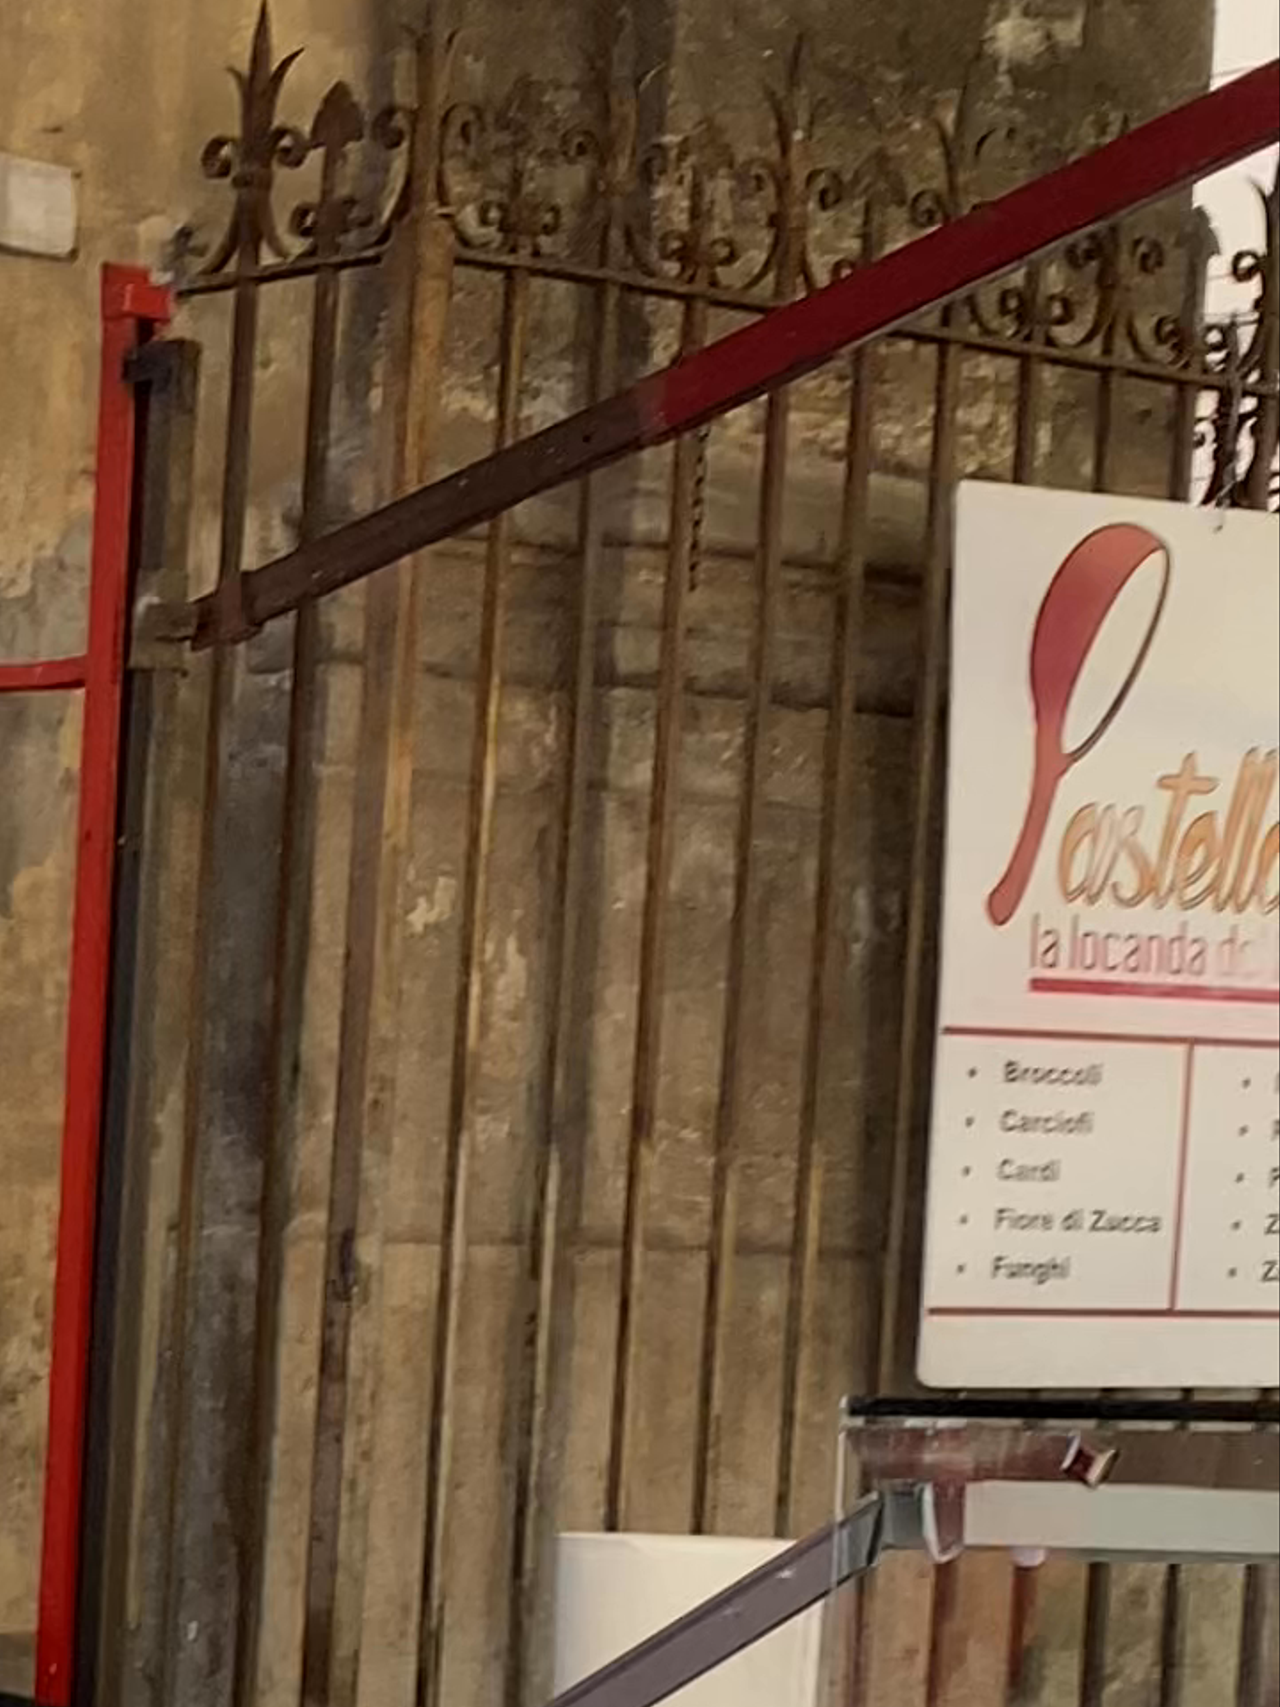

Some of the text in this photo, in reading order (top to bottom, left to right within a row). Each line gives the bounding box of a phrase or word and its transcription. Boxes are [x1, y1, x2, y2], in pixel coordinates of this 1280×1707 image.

[1030, 912, 1060, 969] la
[1069, 913, 1208, 977] locanda
[1002, 1060, 1104, 1087] Broccoli
[999, 1108, 1095, 1134] Carciofi
[996, 1158, 1061, 1182] Cardi
[994, 1207, 1163, 1233] Fiore di Zucca
[990, 1255, 1072, 1285] Funghi
